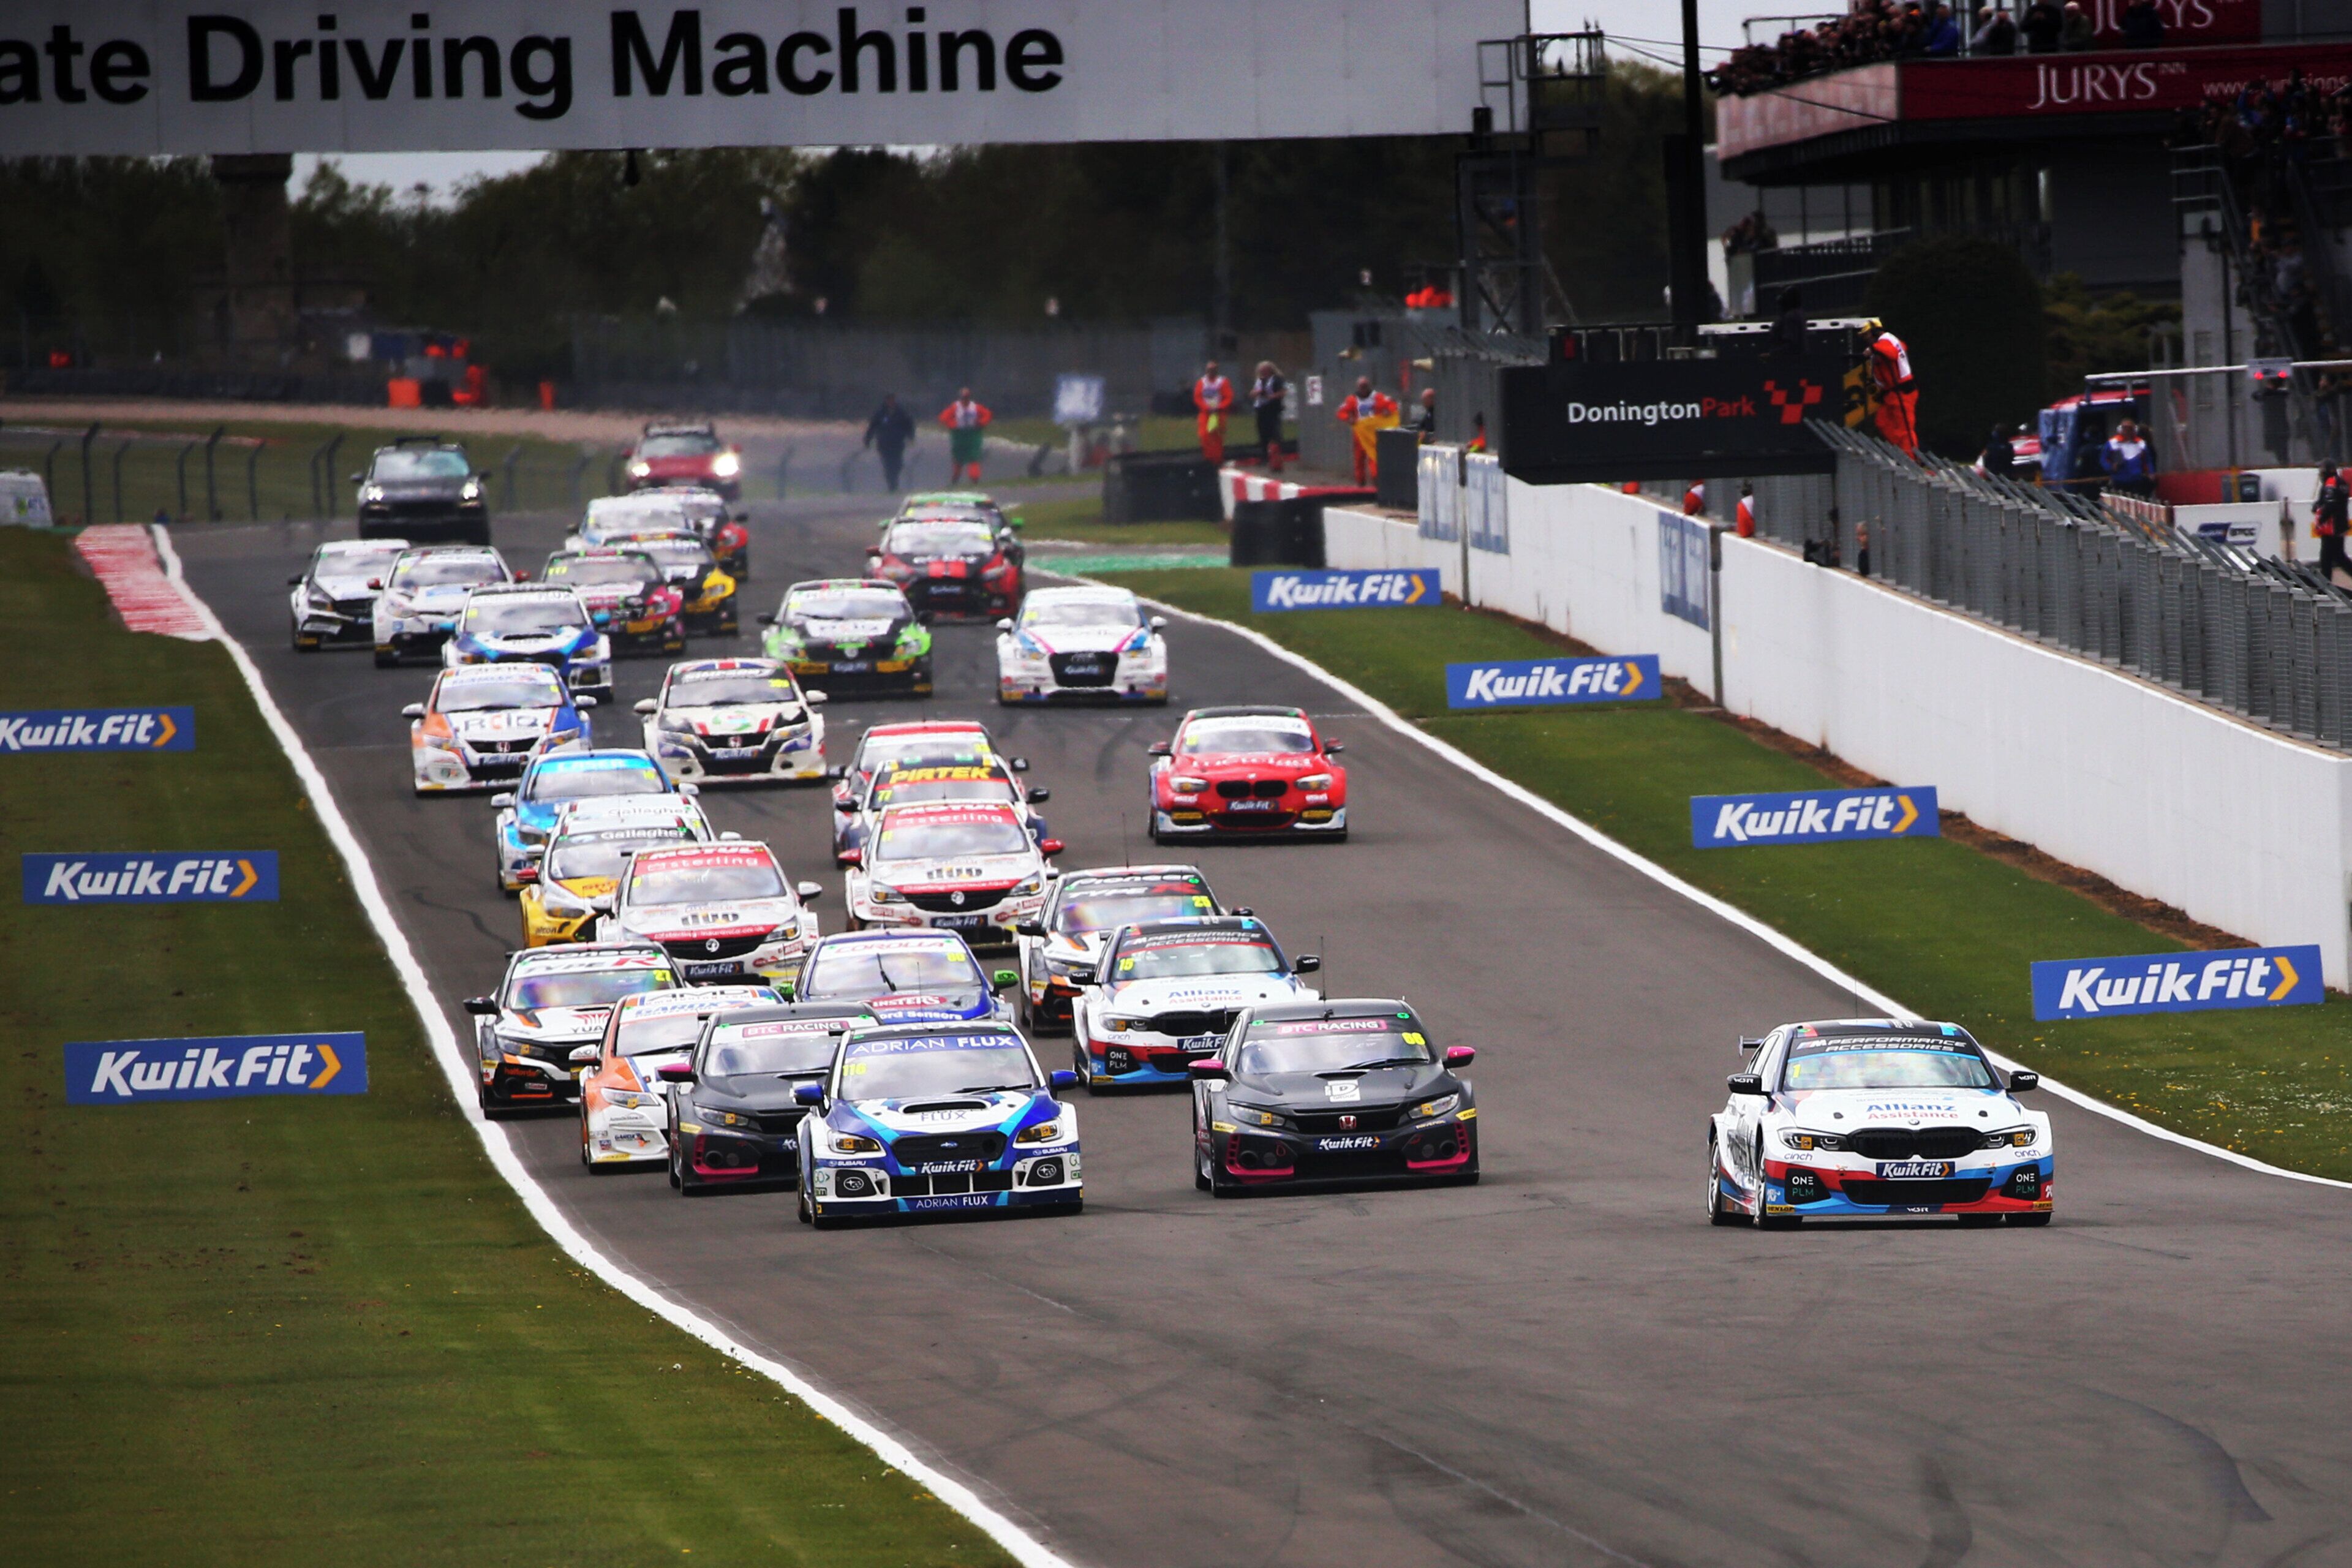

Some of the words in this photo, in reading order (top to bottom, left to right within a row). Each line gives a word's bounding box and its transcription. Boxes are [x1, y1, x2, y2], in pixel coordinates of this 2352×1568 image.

[187, 13, 573, 119] Driving
[611, 7, 1065, 97] Machine
[2026, 62, 2158, 109] JURYS
[889, 767, 992, 784] PIRTEK
[919, 813, 1003, 824] sterling
[601, 827, 685, 840] Gallagher
[650, 846, 755, 859] MOTUL
[671, 856, 758, 868] sterling
[1147, 931, 1261, 941] PERFORMANCE
[835, 941, 943, 952] COROLLA
[1145, 937, 1250, 948] ACCESSORIES
[1118, 957, 1134, 971] 15
[1168, 989, 1242, 998] Allianz
[1169, 995, 1243, 1005] Assistance
[907, 1009, 962, 1020] Sensors
[747, 1026, 777, 1036] BTC
[783, 1022, 842, 1033] RACING
[1281, 1025, 1313, 1033] BTC
[1318, 1021, 1379, 1030] RACING
[852, 1038, 946, 1055] ADRIAN
[957, 1036, 1015, 1048] FLUX
[1828, 1037, 1967, 1047] PERFORMANCE
[1792, 1065, 1801, 1078] 1
[1866, 1103, 1957, 1112] Allianz
[921, 1110, 966, 1122] FLUX
[1868, 1111, 1959, 1120] Assistance
[1784, 1153, 1813, 1161] cinch
[2015, 1149, 2041, 1158] cinch
[1792, 1176, 1814, 1185] ONE
[2016, 1174, 2035, 1182] ONE
[1792, 1188, 1814, 1196] PLM
[916, 1197, 958, 1208] ADRIAN
[963, 1196, 989, 1206] FLUX
